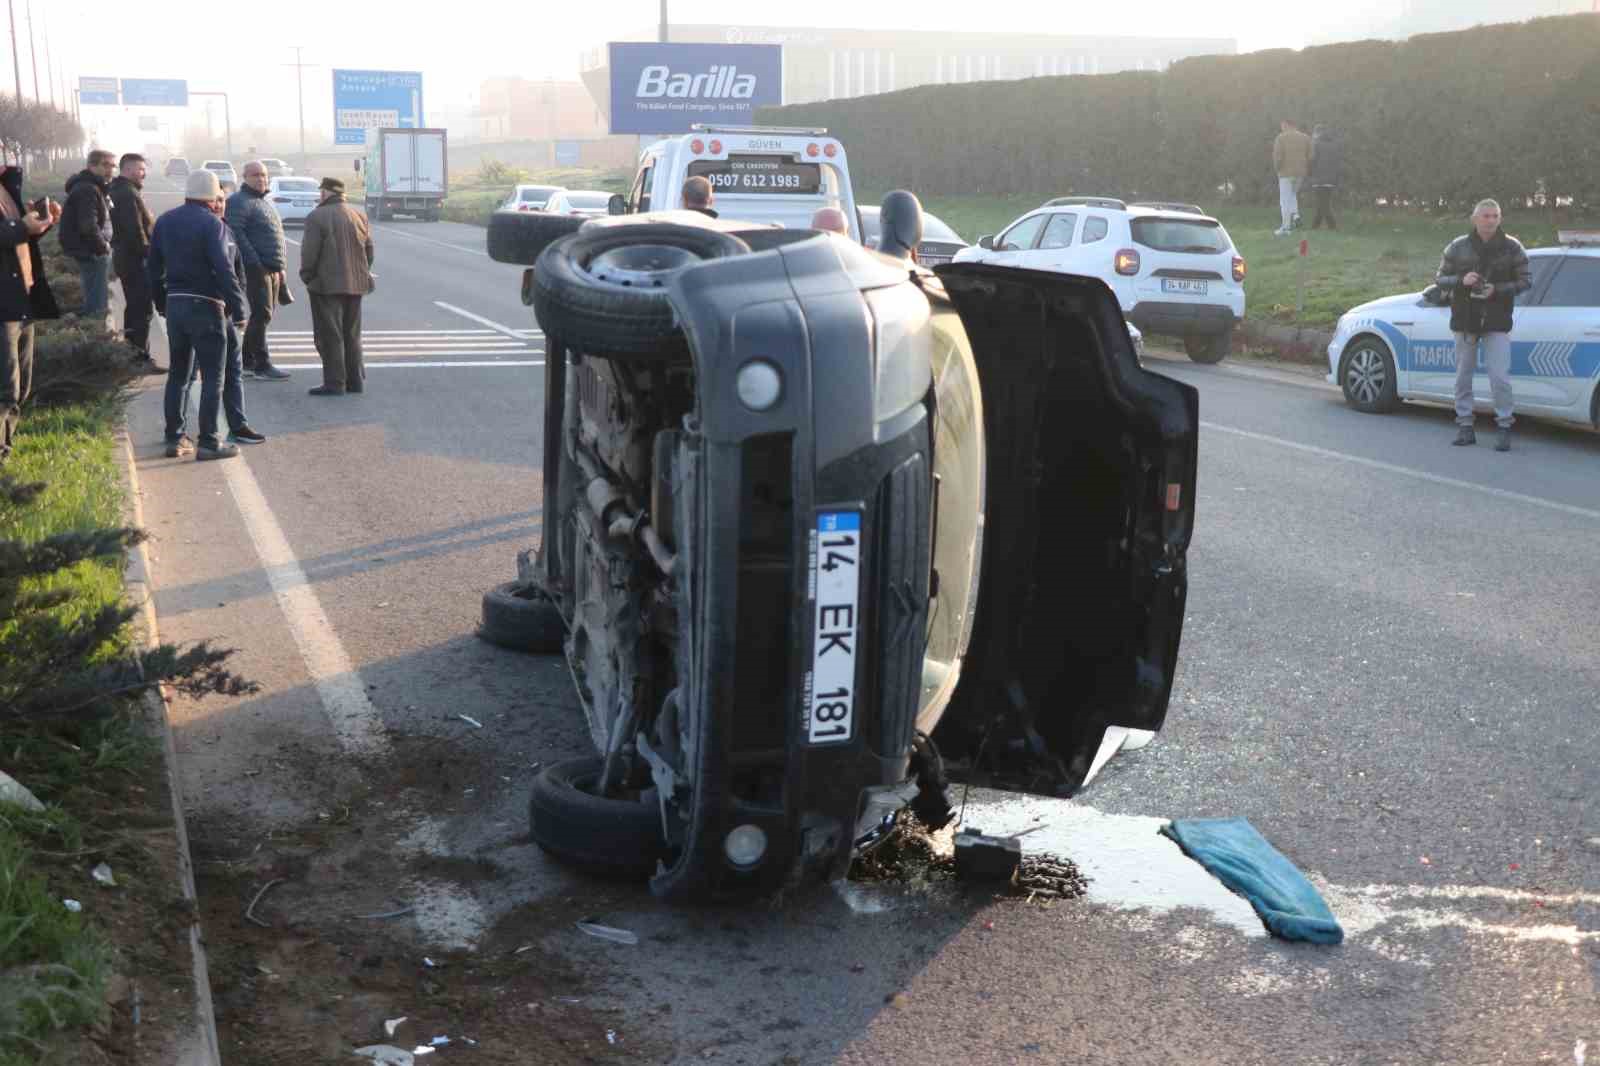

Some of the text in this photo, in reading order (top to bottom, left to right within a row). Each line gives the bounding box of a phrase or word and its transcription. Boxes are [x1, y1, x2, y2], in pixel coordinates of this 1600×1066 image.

[636, 65, 757, 98] Barilla
[708, 173, 800, 188] 0507 612 1983
[814, 535, 855, 737] 14 EK 181
